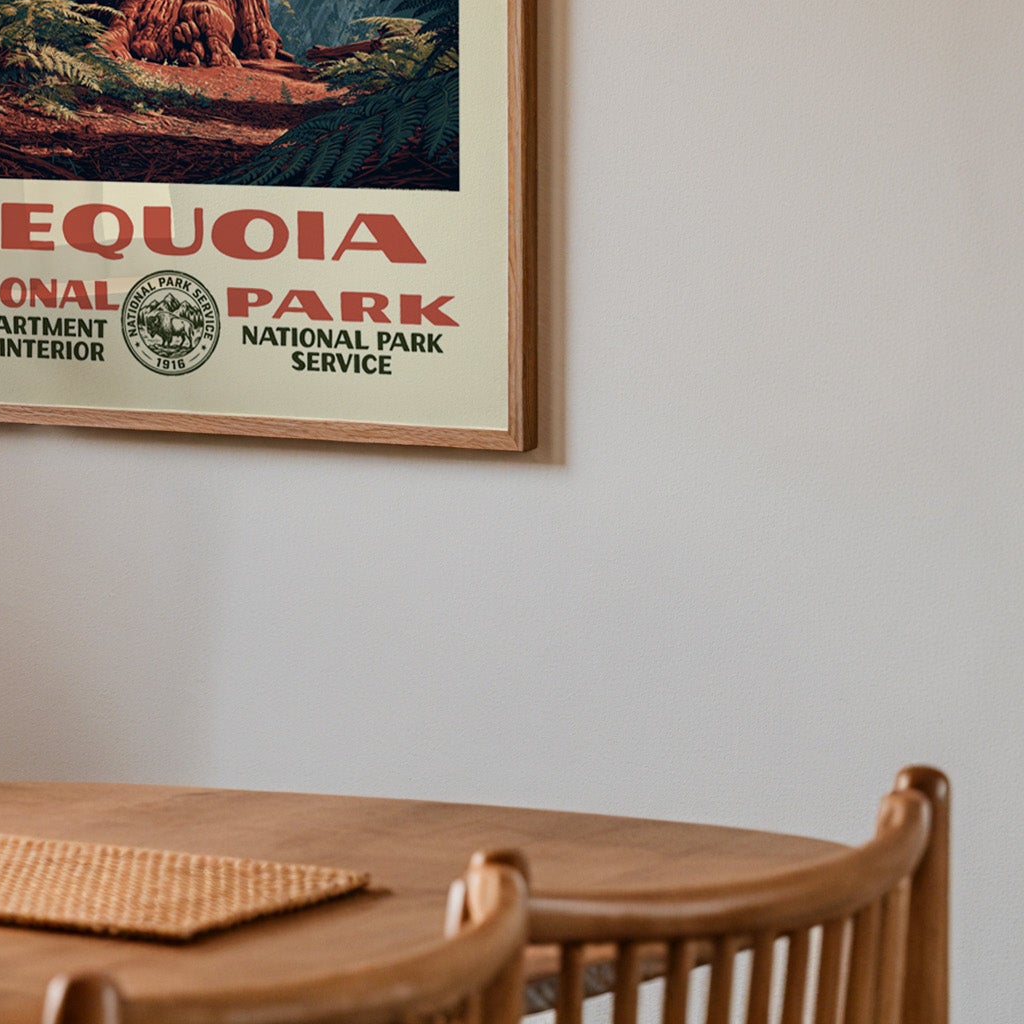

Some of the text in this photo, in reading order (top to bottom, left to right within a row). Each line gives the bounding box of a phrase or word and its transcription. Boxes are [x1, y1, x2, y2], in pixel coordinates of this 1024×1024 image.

[127, 276, 215, 341] NATIONAL PARK SERVICE
[226, 287, 460, 327] PARK
[0, 338, 105, 362] INTERIOR
[242, 325, 444, 354] NATIONAL PARK
[157, 358, 186, 370] 1916
[291, 351, 392, 375] SERVICE
